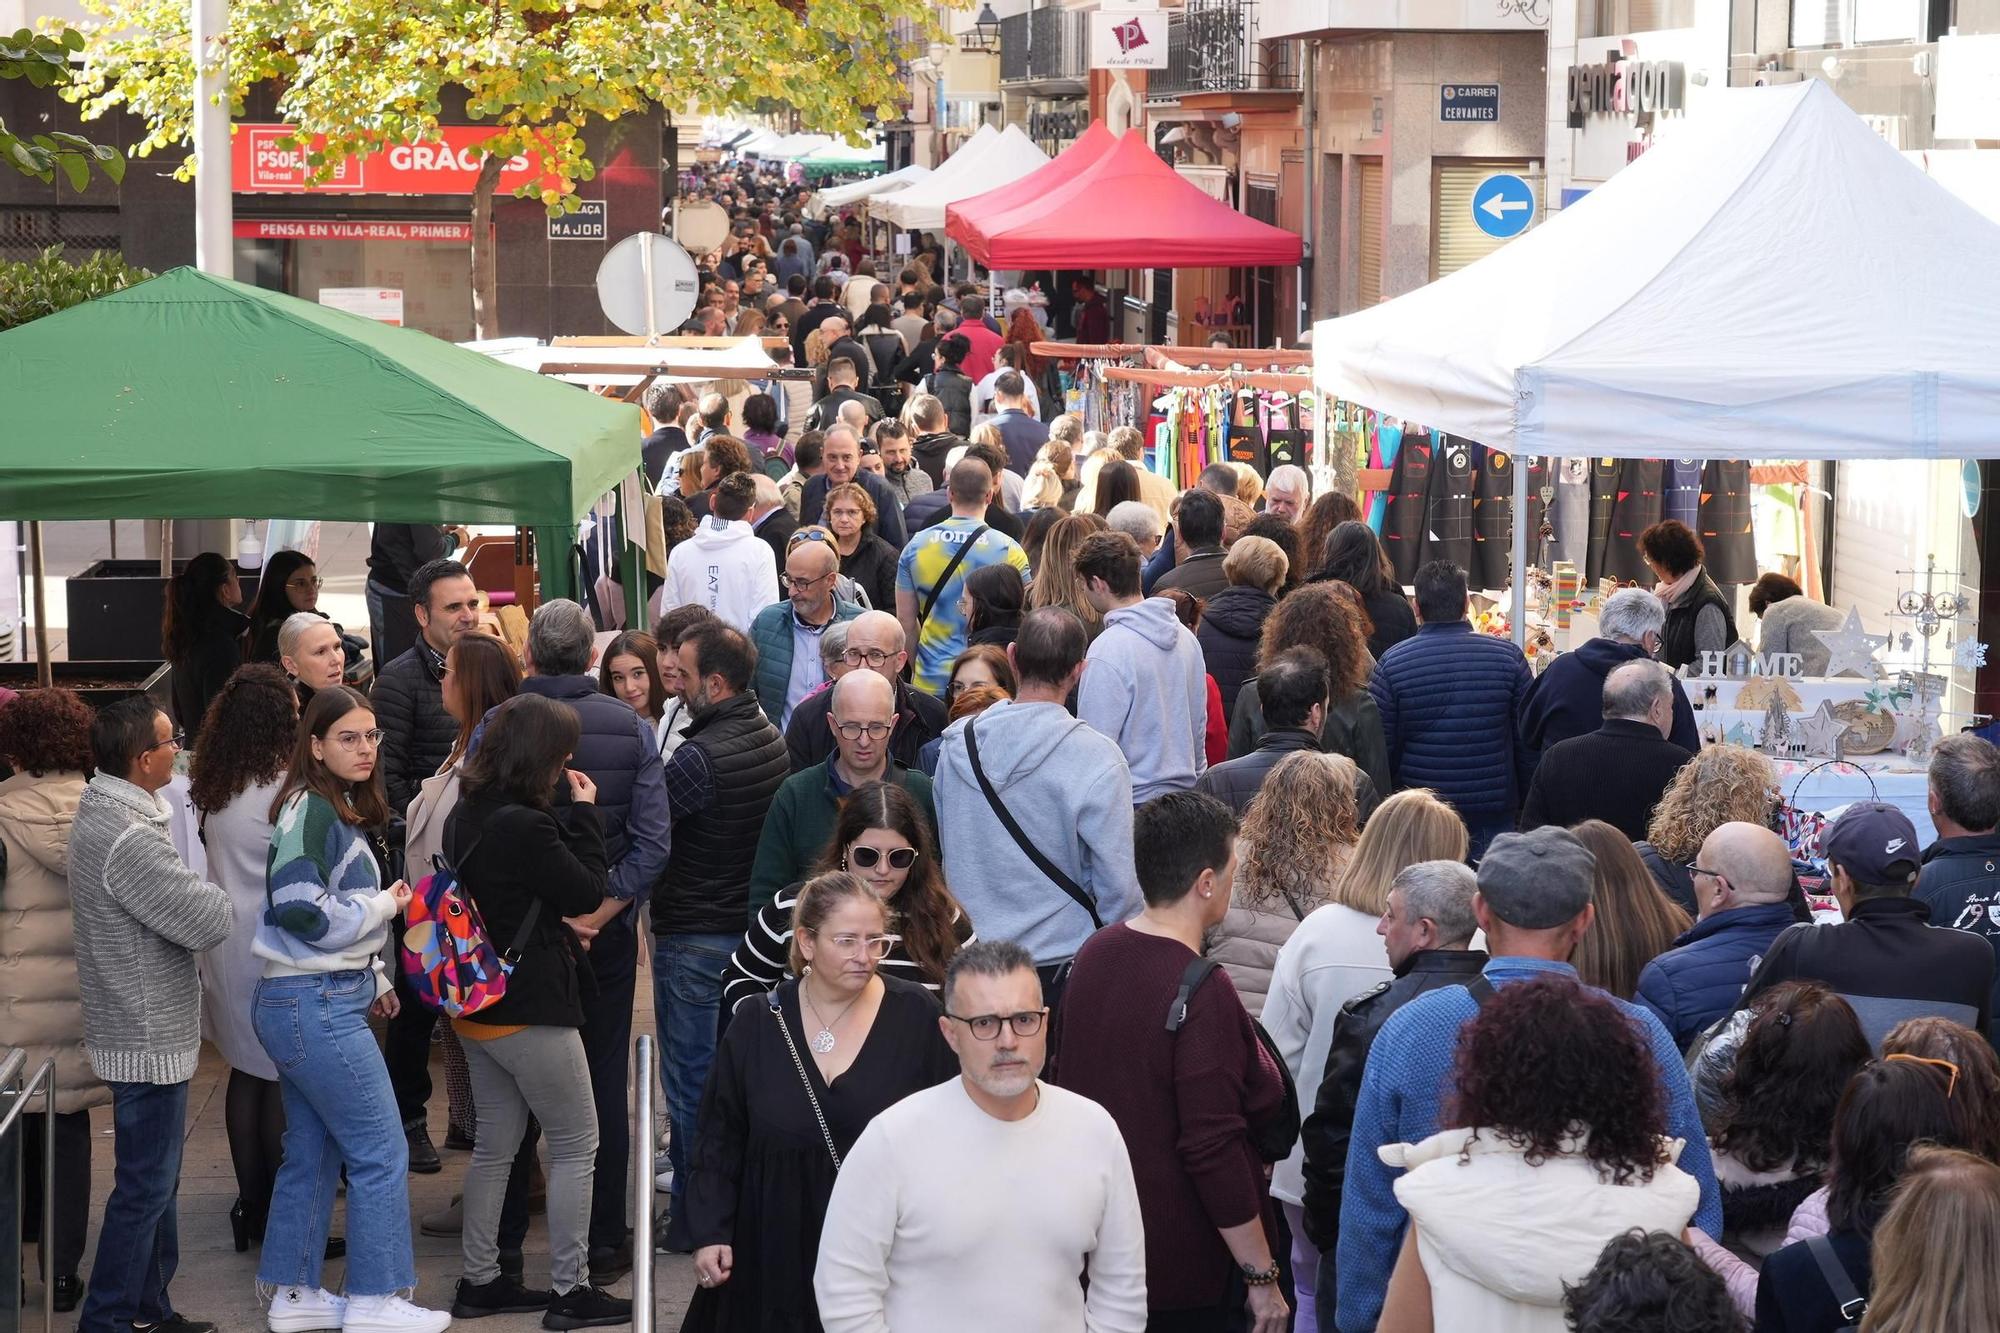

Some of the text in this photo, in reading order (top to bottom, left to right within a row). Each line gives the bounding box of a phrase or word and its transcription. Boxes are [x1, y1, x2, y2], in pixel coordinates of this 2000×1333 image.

[1106, 57, 1130, 65] desde
[1458, 88, 1497, 97] CARRER
[1445, 107, 1494, 119] CERVANTES
[257, 151, 299, 168] PSOE
[260, 224, 305, 235] PENSA
[309, 225, 328, 236] EN
[332, 225, 407, 239] VILA-REAL,
[411, 226, 461, 238] PRIMER
[552, 224, 602, 235] MAJOR
[708, 565, 719, 594] EA7
